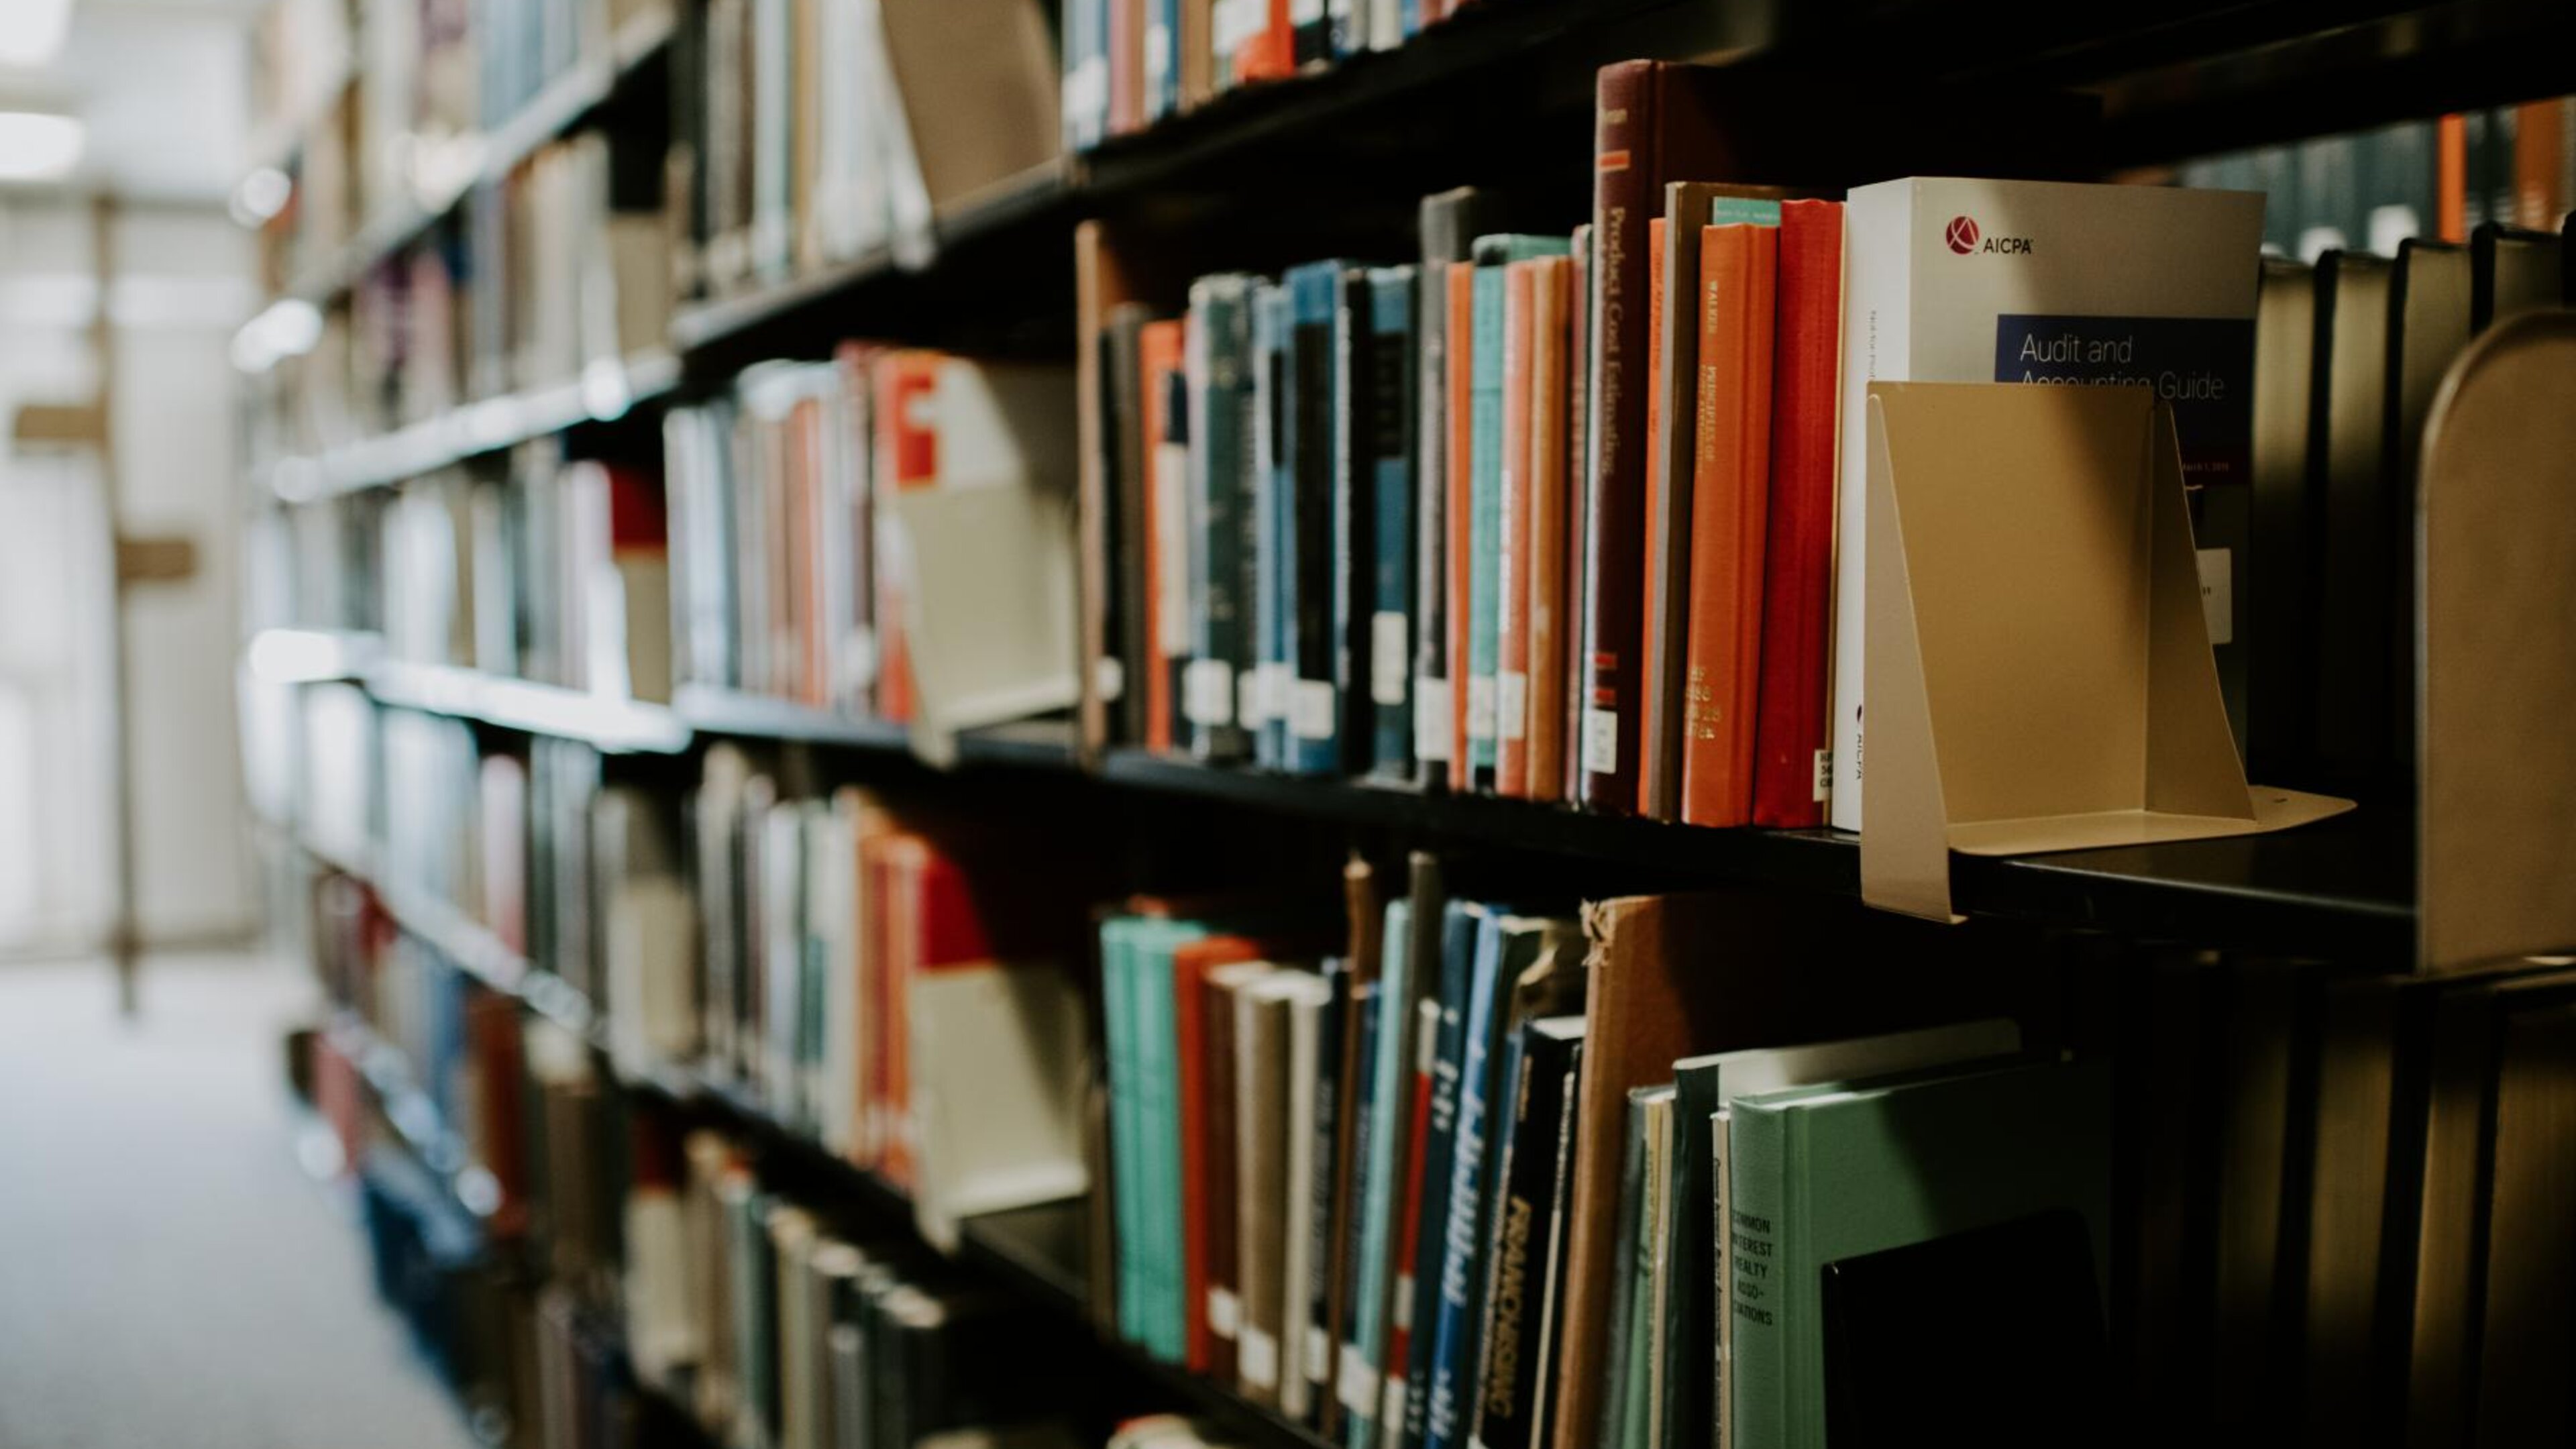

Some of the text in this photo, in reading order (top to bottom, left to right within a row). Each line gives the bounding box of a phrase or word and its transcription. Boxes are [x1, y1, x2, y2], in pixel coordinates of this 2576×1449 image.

[1609, 207, 1626, 295] Product
[1983, 237, 2033, 255] AICPA
[1608, 303, 1624, 353] Cost
[2019, 333, 2133, 363] Audit and
[2158, 371, 2224, 400] Guide
